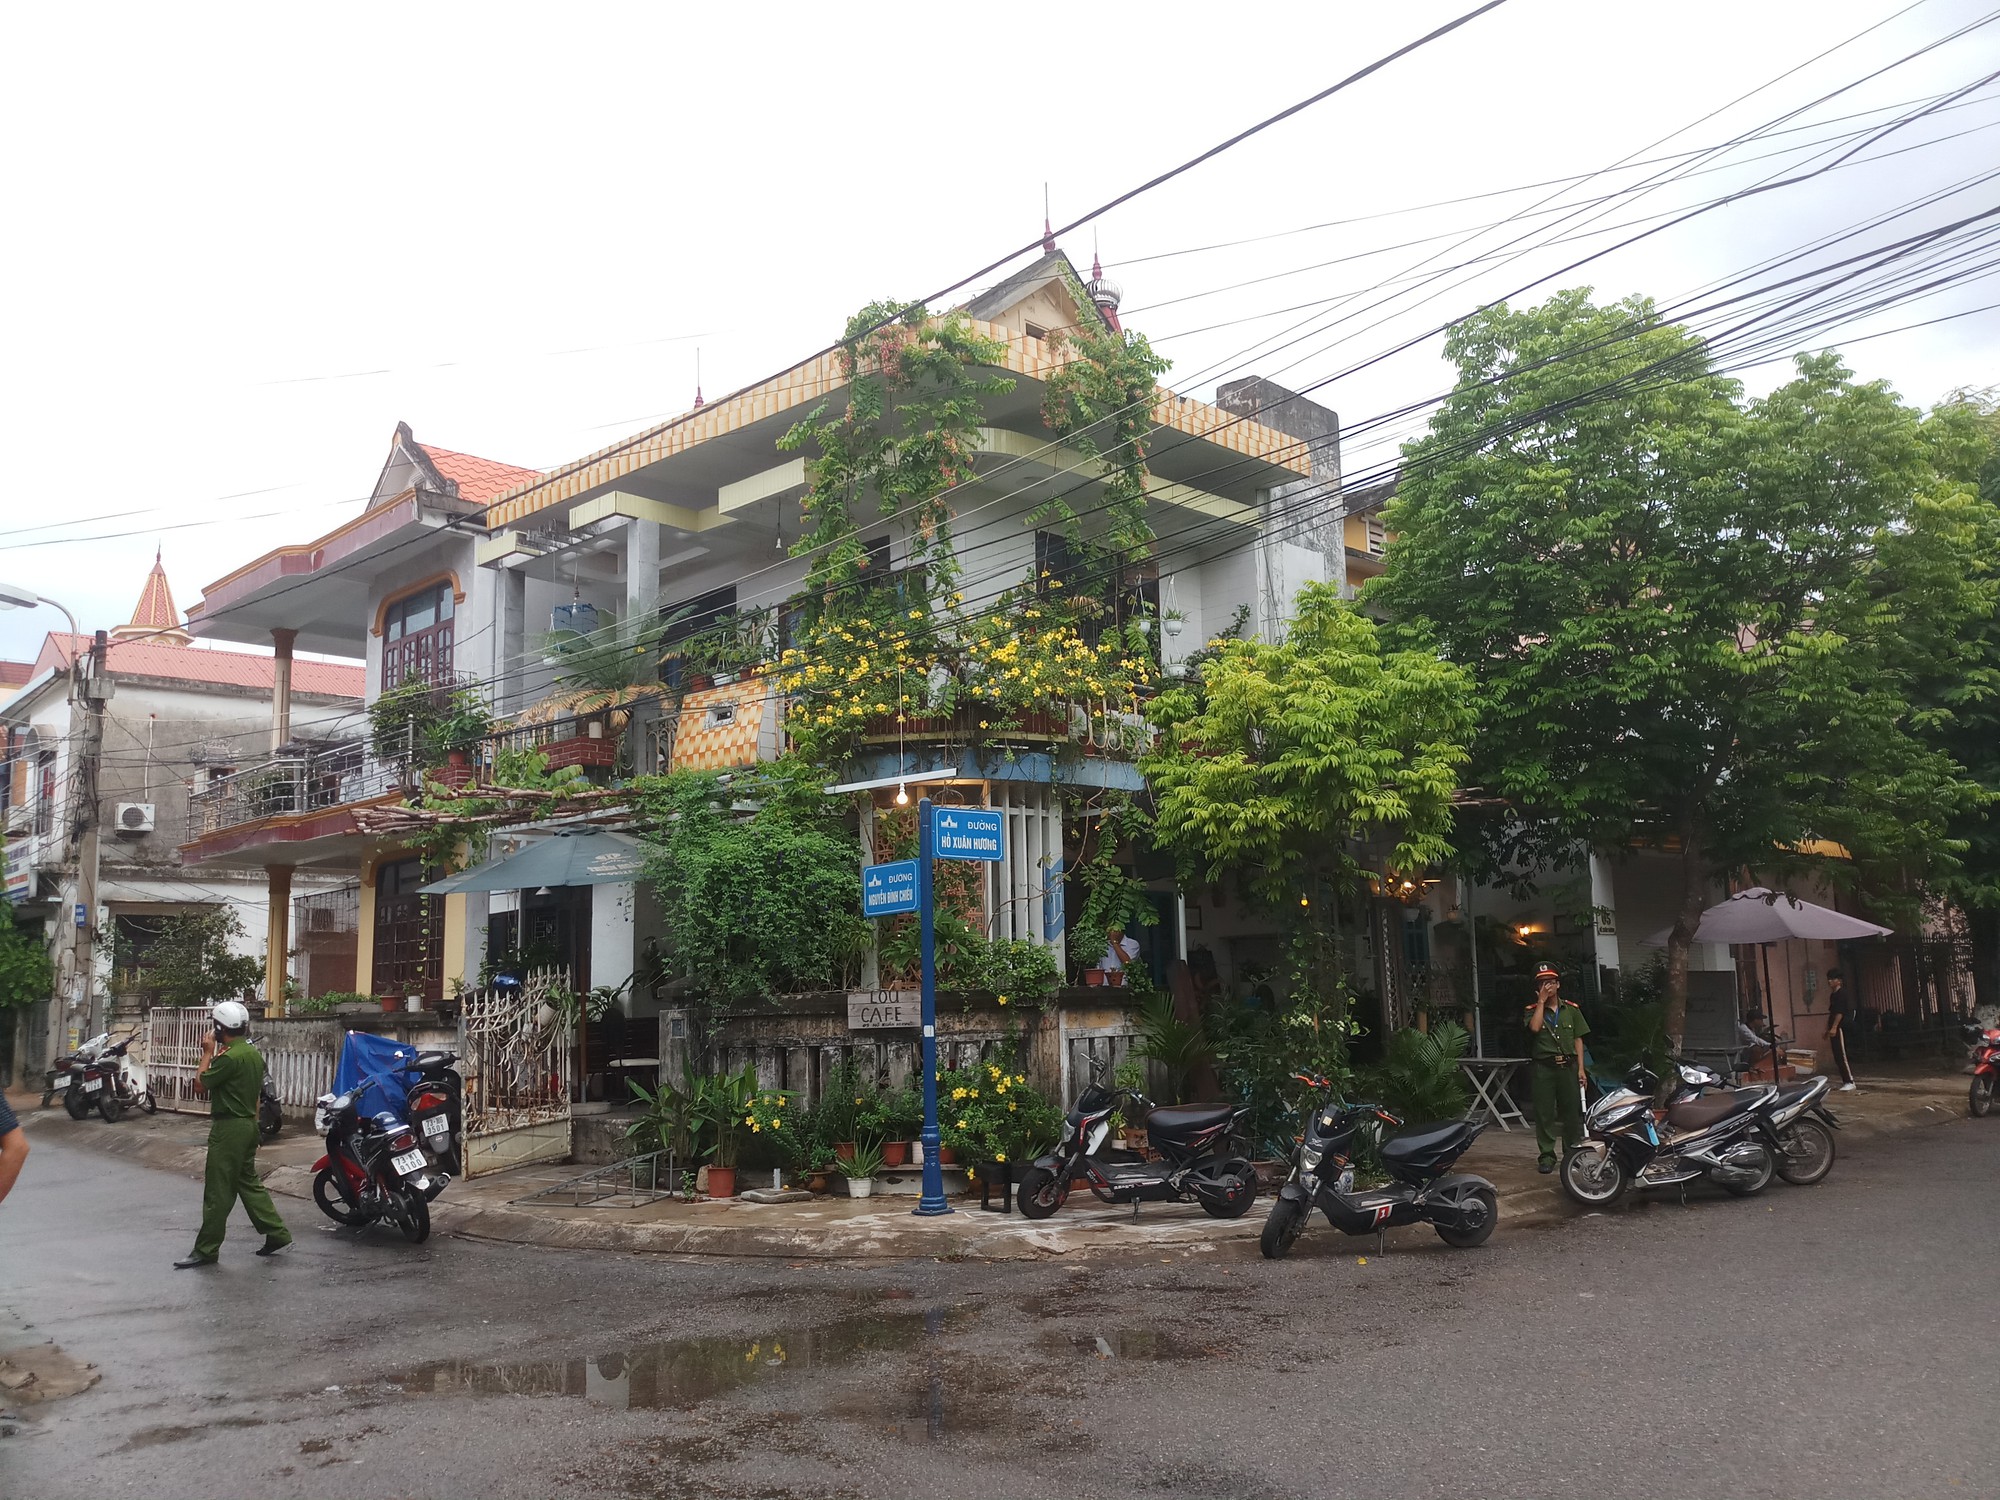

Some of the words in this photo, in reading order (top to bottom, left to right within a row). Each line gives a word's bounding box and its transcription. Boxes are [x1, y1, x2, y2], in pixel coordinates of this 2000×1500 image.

[967, 820, 997, 831] ĐƯỜNG
[941, 832, 951, 848] HỒ
[952, 835, 972, 850] XUÂN
[973, 837, 997, 851] HƯƠNG
[888, 872, 913, 884] ĐƯỜNG
[861, 1006, 902, 1022] CAFE
[427, 1124, 445, 1135] 3501
[400, 1159, 423, 1173] 8100
[1380, 1209, 1386, 1218] 1
